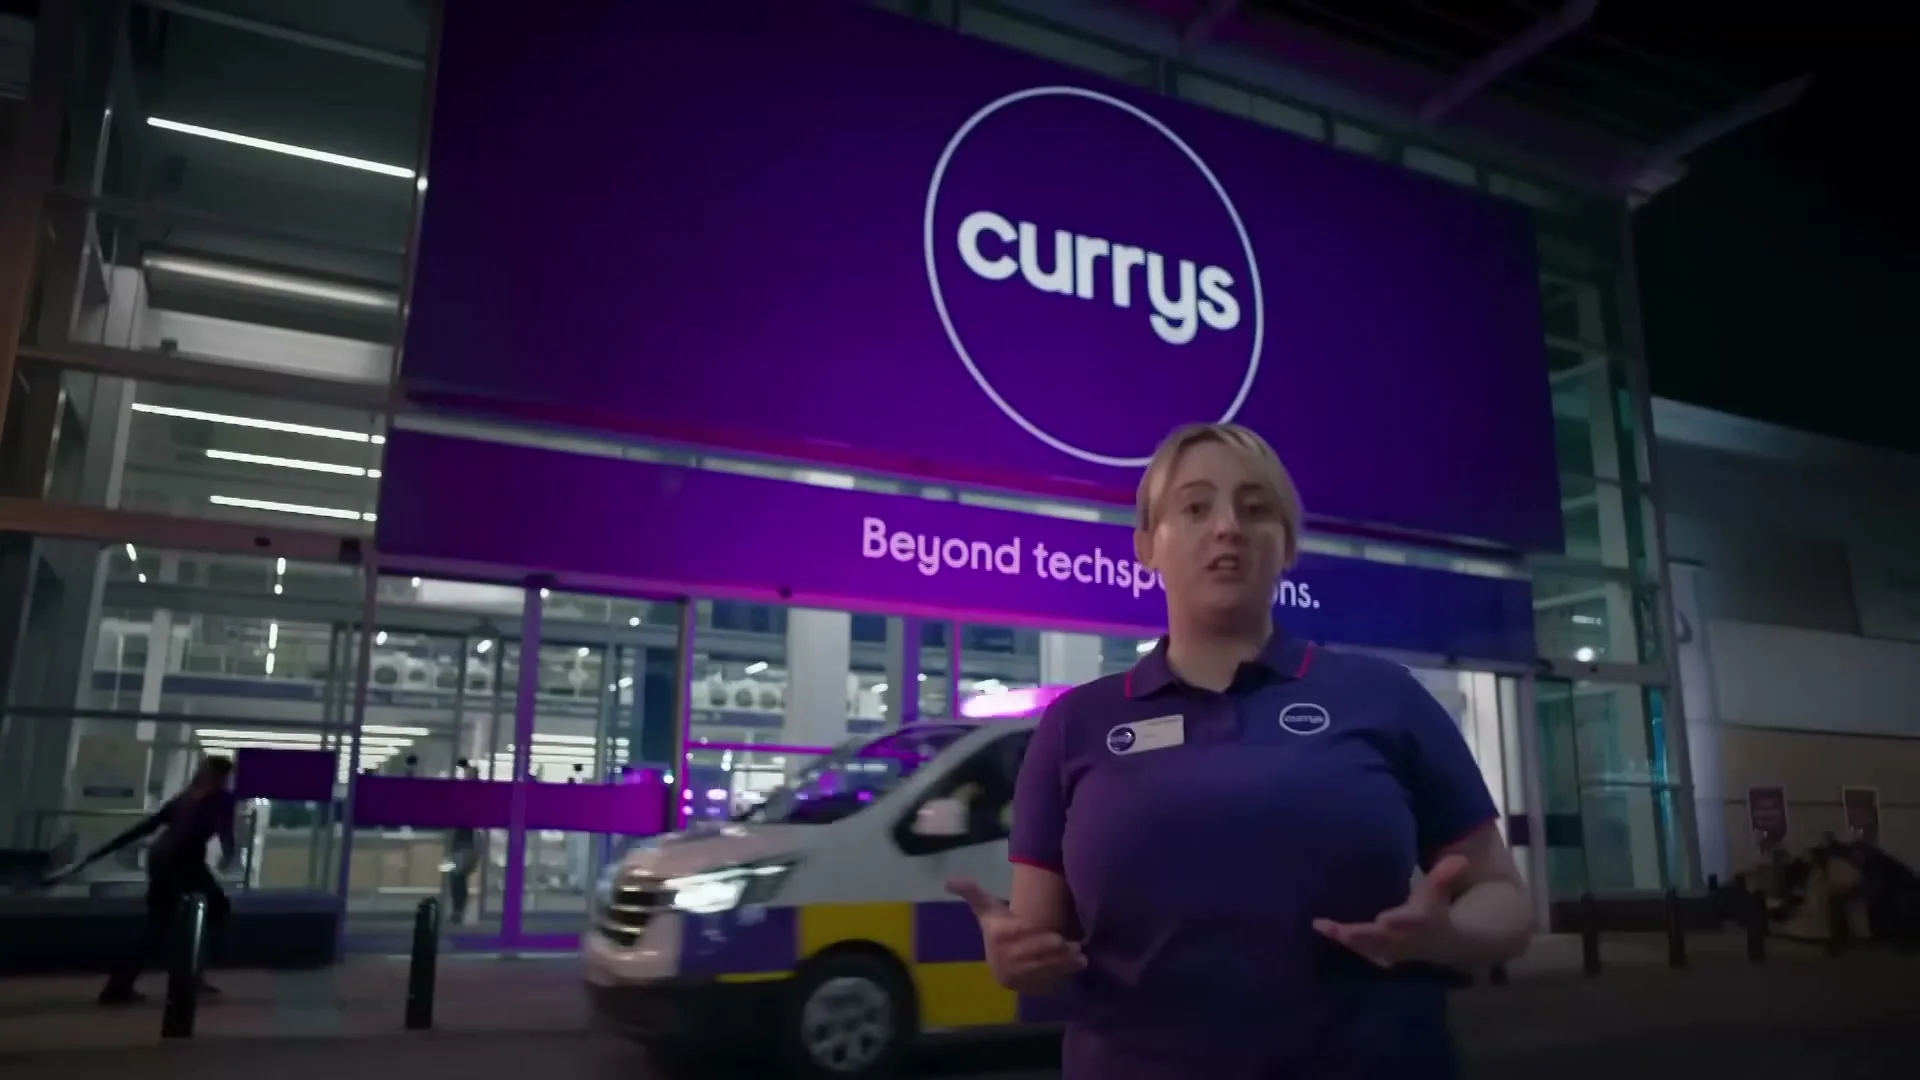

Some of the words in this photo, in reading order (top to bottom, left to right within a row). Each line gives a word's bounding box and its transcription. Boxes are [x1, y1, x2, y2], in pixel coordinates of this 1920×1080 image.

[957, 210, 1241, 345] currys
[862, 516, 1021, 576] Beyond
[1032, 541, 1320, 609] techspns.
